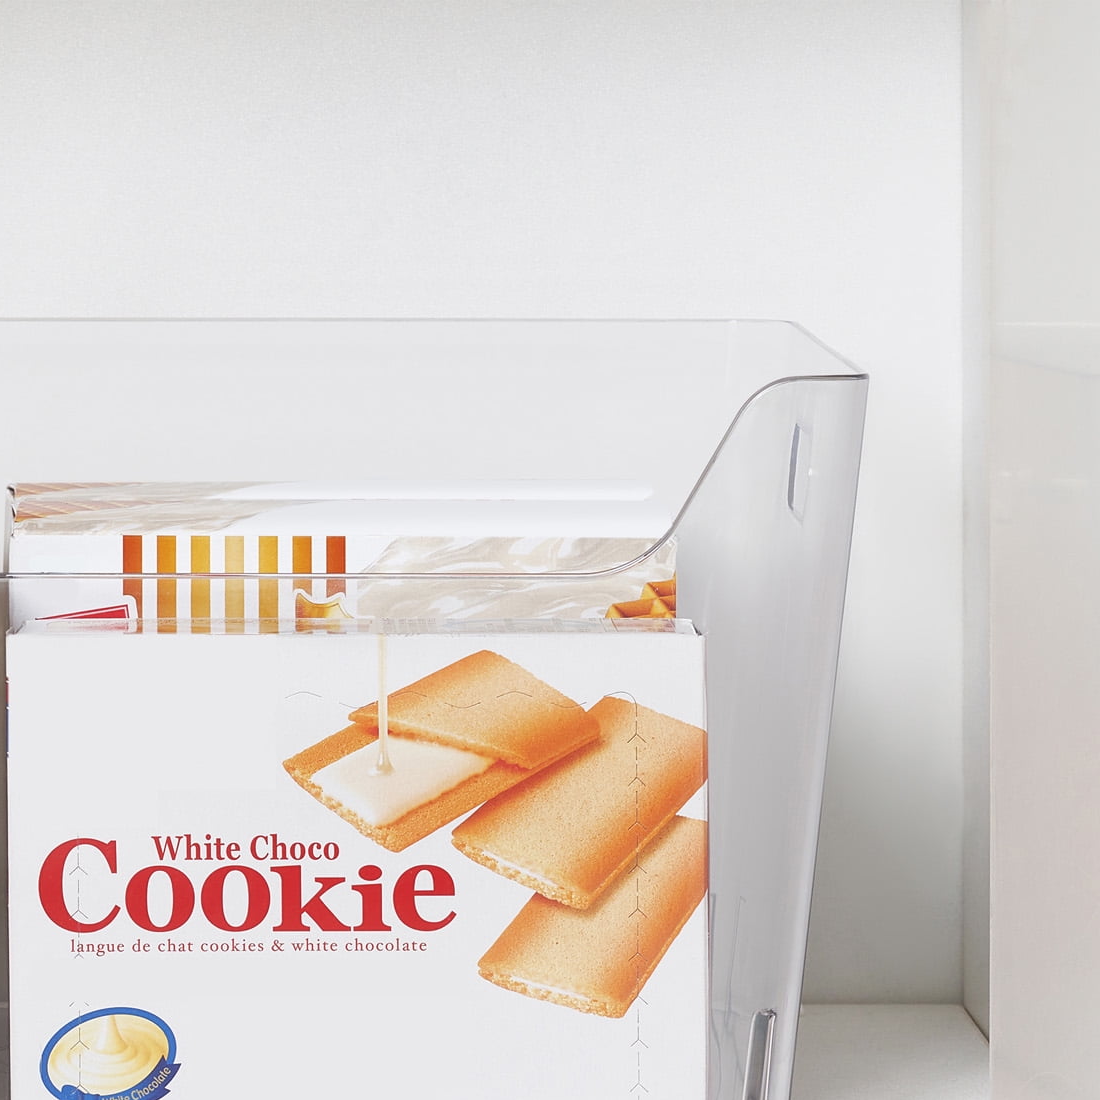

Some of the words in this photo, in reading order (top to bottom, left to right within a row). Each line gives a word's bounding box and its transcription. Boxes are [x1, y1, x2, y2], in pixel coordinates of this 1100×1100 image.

[152, 834, 241, 861] White
[249, 834, 340, 861] Choco
[38, 837, 457, 934] Cookie
[71, 938, 125, 957] langue
[131, 938, 151, 953] de
[157, 938, 194, 953] chat
[200, 938, 265, 953] cookies
[270, 939, 285, 953] &
[291, 938, 339, 953] white
[344, 938, 428, 953] chocolate
[130, 1066, 172, 1100] Chocolate
